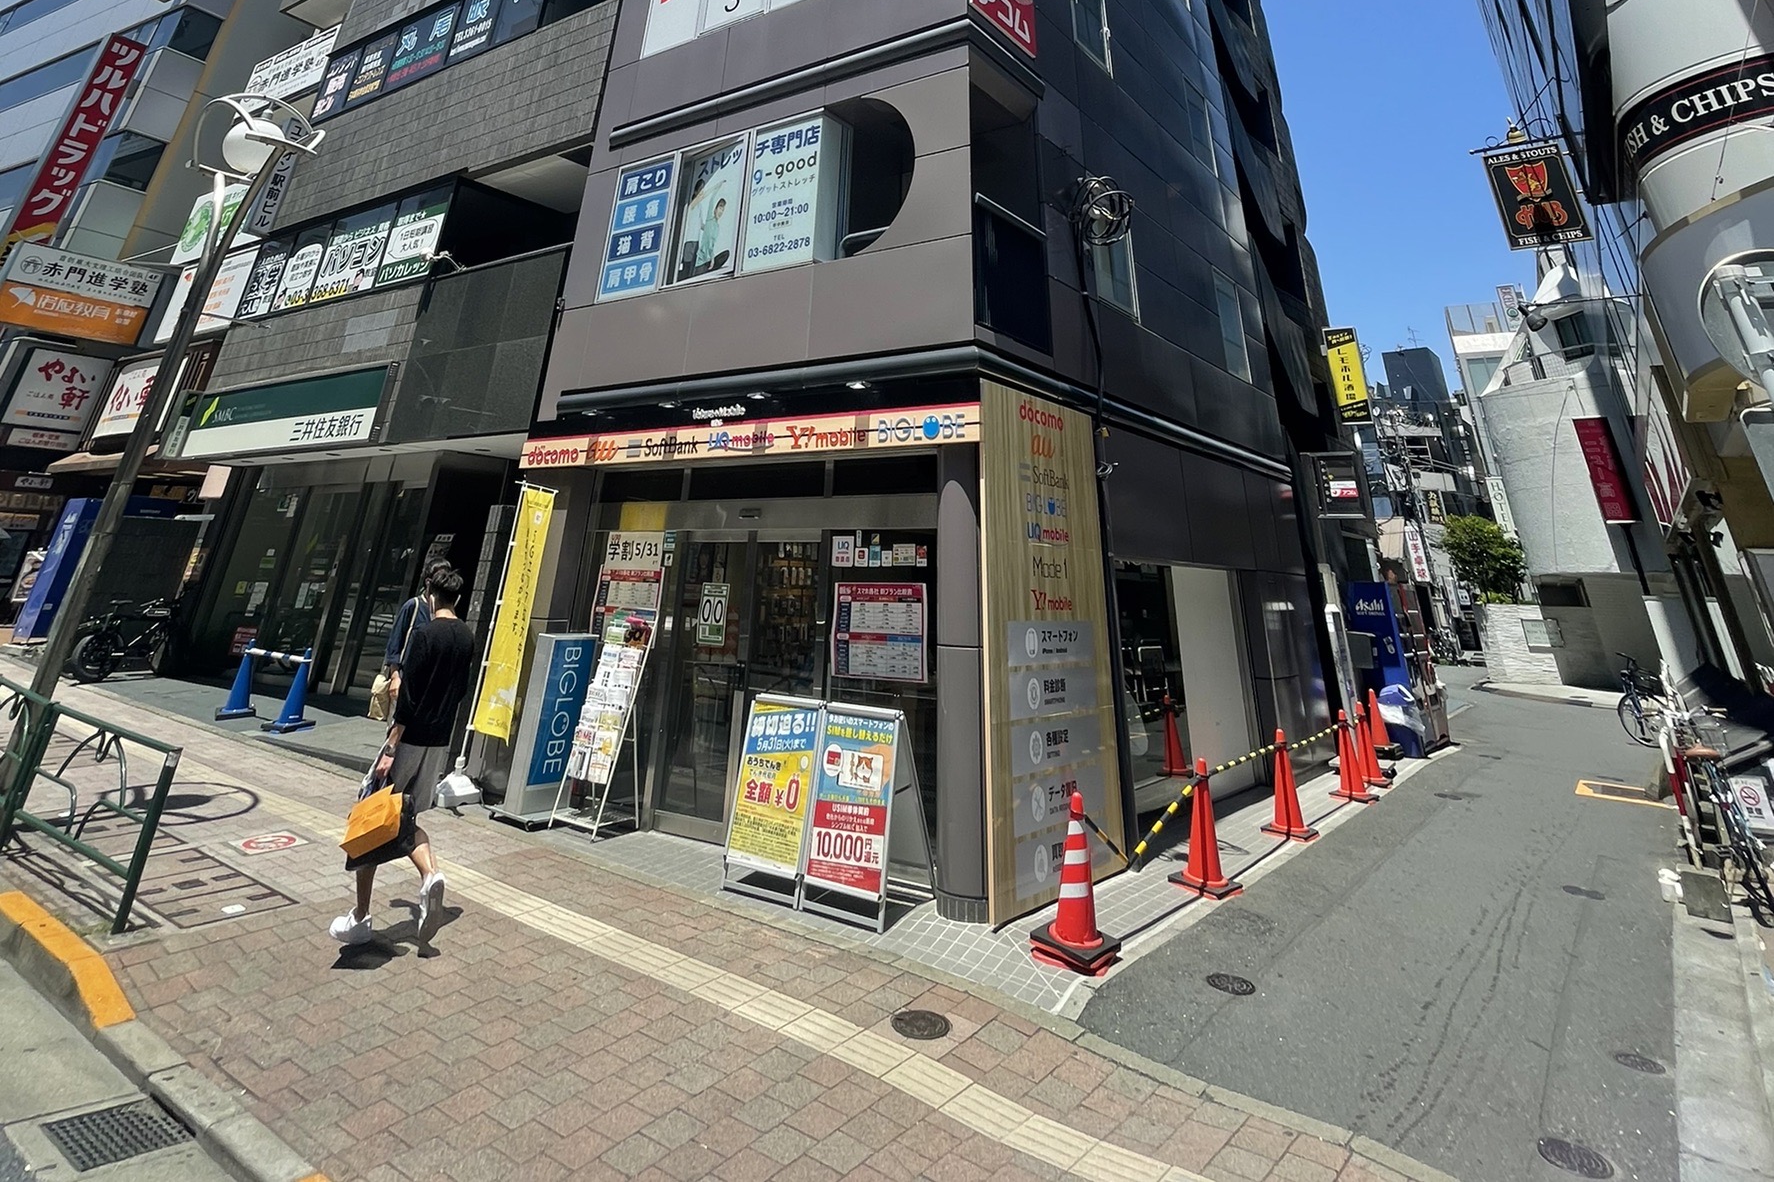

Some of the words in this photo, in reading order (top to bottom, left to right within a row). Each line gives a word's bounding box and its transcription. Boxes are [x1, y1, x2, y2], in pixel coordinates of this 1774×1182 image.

[29, 42, 144, 216] ツルハドラッグ
[1623, 122, 1649, 164] ISH
[1650, 114, 1670, 136] &
[1671, 73, 1774, 123] CHIPS
[1487, 155, 1511, 165] ALES
[1520, 146, 1558, 159] STOUTS
[624, 169, 667, 195] 肩こり
[617, 230, 655, 256] 猫背
[747, 236, 811, 259] 03-6822-2878
[1518, 235, 1541, 246] FISH
[1552, 230, 1584, 242] CHIPS
[320, 235, 387, 278] パソコン
[42, 262, 149, 298] 赤門進学塾
[607, 261, 653, 290] 肩甲骨
[60, 386, 90, 410] 軒
[213, 407, 238, 423] SMBC
[290, 414, 364, 441] 三井住友銀行
[1019, 400, 1064, 431] docomo
[528, 445, 579, 466] docomo
[586, 440, 619, 463] au
[644, 435, 699, 458] SoftBank
[707, 432, 730, 452] UQ
[732, 429, 775, 448] mobile
[786, 425, 813, 450] Y!
[816, 428, 866, 448] mobile
[877, 413, 966, 444] BIGLOBE
[1032, 433, 1056, 459] au
[1032, 465, 1070, 490] SoftBank
[1026, 493, 1067, 518] BIGLOBE
[1027, 522, 1042, 542] UQ
[1042, 527, 1070, 543] mobile
[609, 540, 634, 561] 学割
[635, 542, 659, 559] 5/31
[1032, 556, 1062, 579] Mode
[1030, 589, 1048, 611] Y!
[1047, 596, 1073, 611] mobile
[1356, 598, 1384, 612] Asahi
[1041, 631, 1079, 645] スマートフォン
[1043, 678, 1066, 694] 料金診断
[543, 647, 582, 774] BIGLOBE
[1045, 729, 1069, 747] 各種設定
[744, 779, 771, 803] 全額
[816, 829, 864, 864] 10,000
